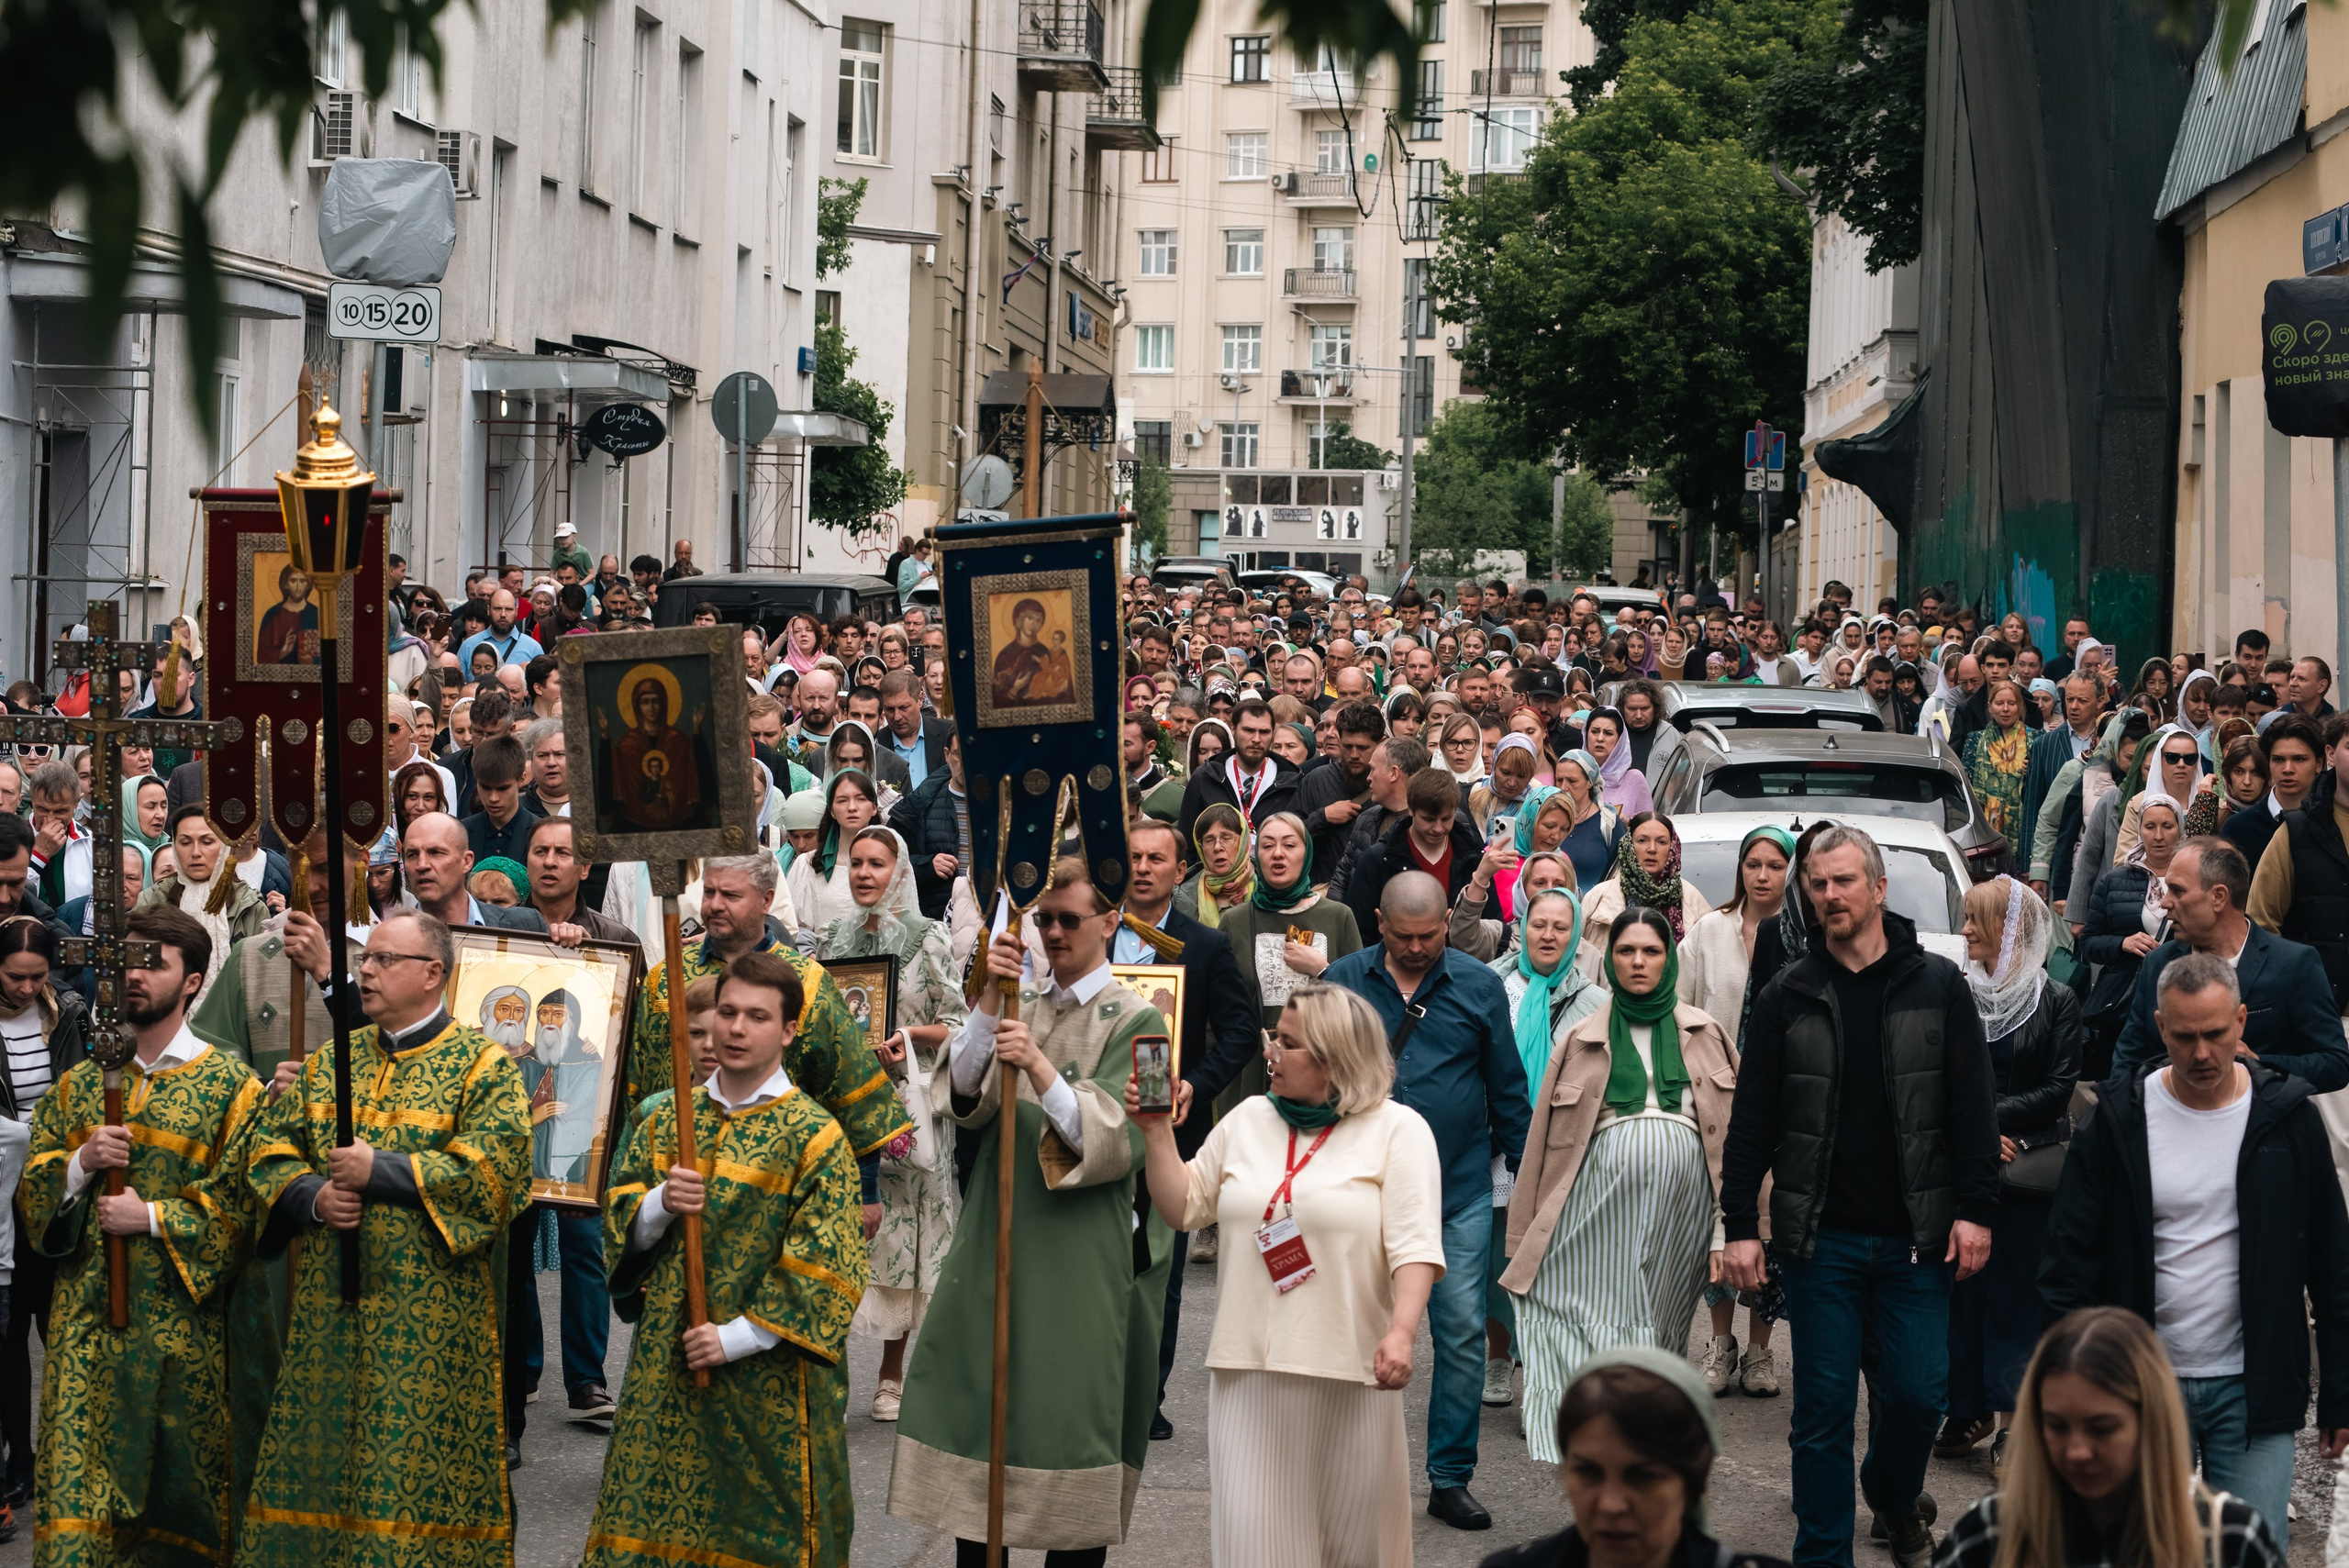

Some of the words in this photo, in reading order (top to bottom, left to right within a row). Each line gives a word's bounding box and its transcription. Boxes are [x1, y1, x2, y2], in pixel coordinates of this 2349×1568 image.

[342, 304, 359, 319] 10
[365, 303, 385, 322] 15
[395, 302, 428, 326] 20
[2273, 355, 2320, 369] Скоро
[2275, 369, 2321, 385] новый
[602, 406, 652, 431] Студия
[599, 434, 651, 452] Красоты
